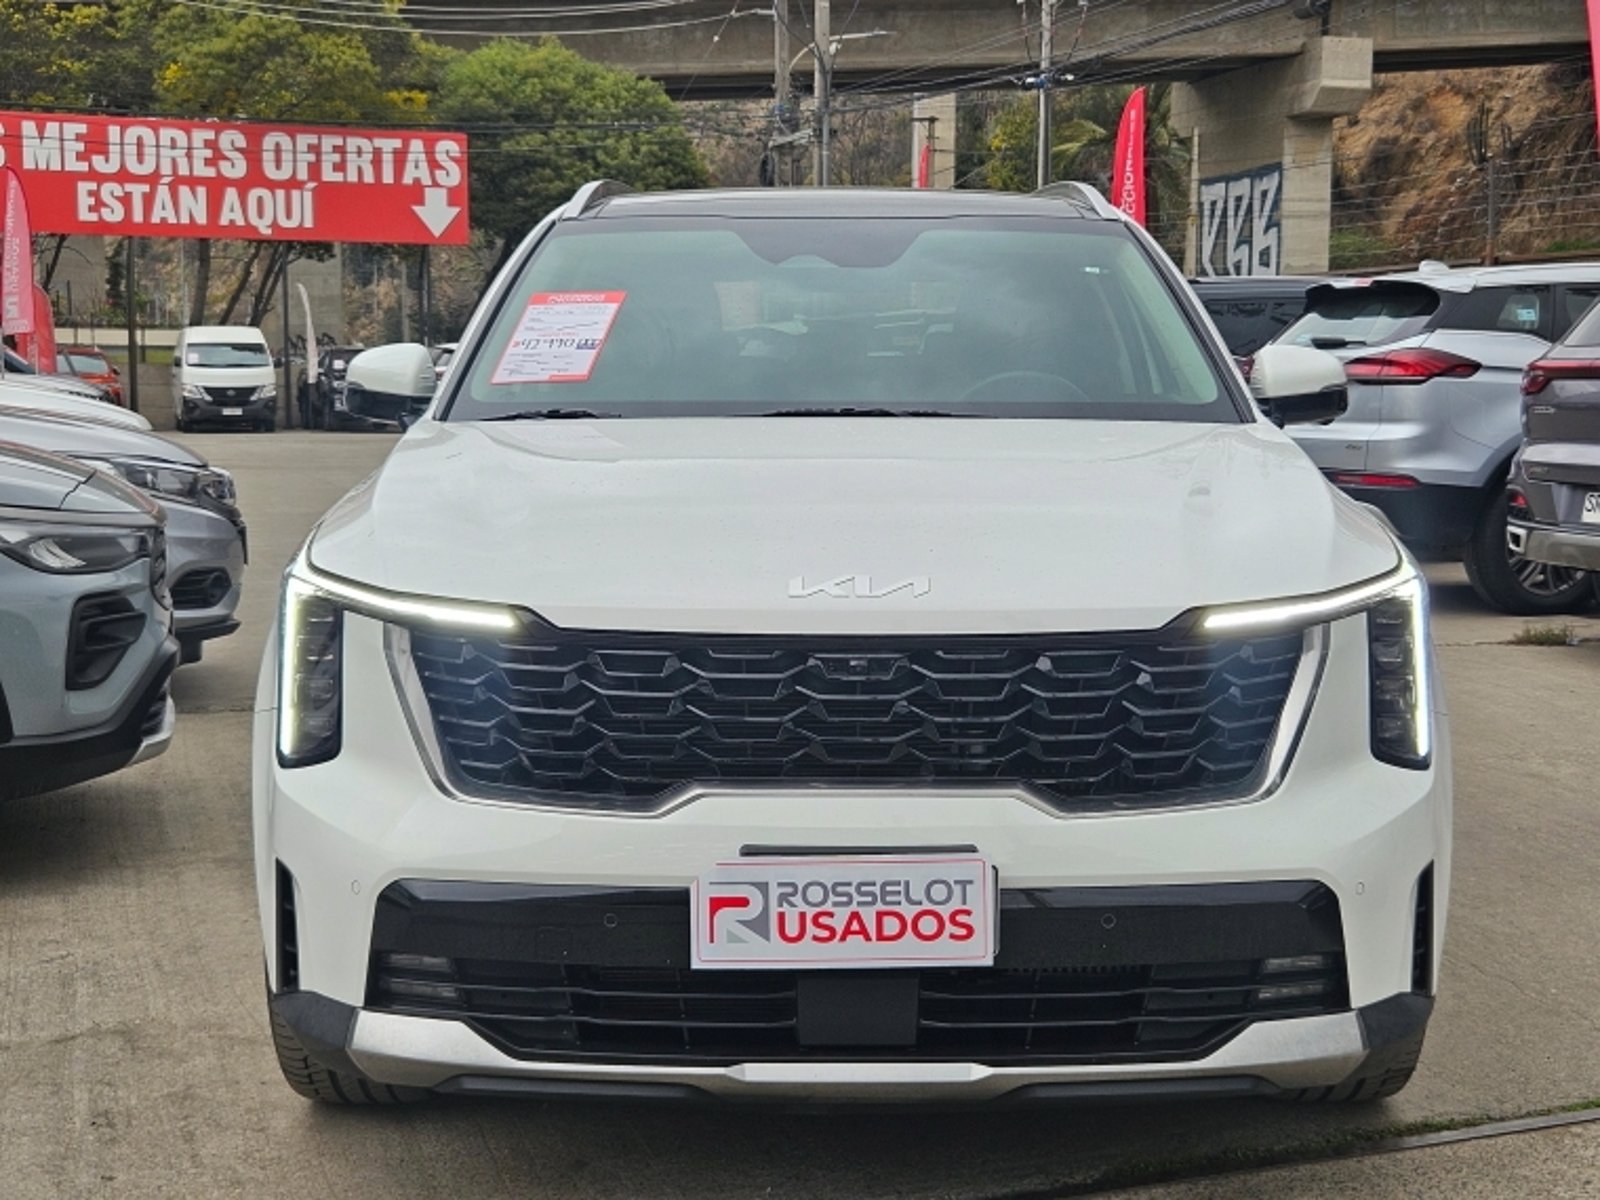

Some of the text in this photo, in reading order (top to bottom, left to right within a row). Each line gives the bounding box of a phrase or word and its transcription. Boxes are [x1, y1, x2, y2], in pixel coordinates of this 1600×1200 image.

[21, 120, 247, 179] MEJORES
[262, 131, 462, 188] OFERTAS
[77, 177, 318, 235] ESTÁN AQUÍ
[776, 879, 974, 908] ROSSELOT
[776, 909, 975, 944] USADOS
